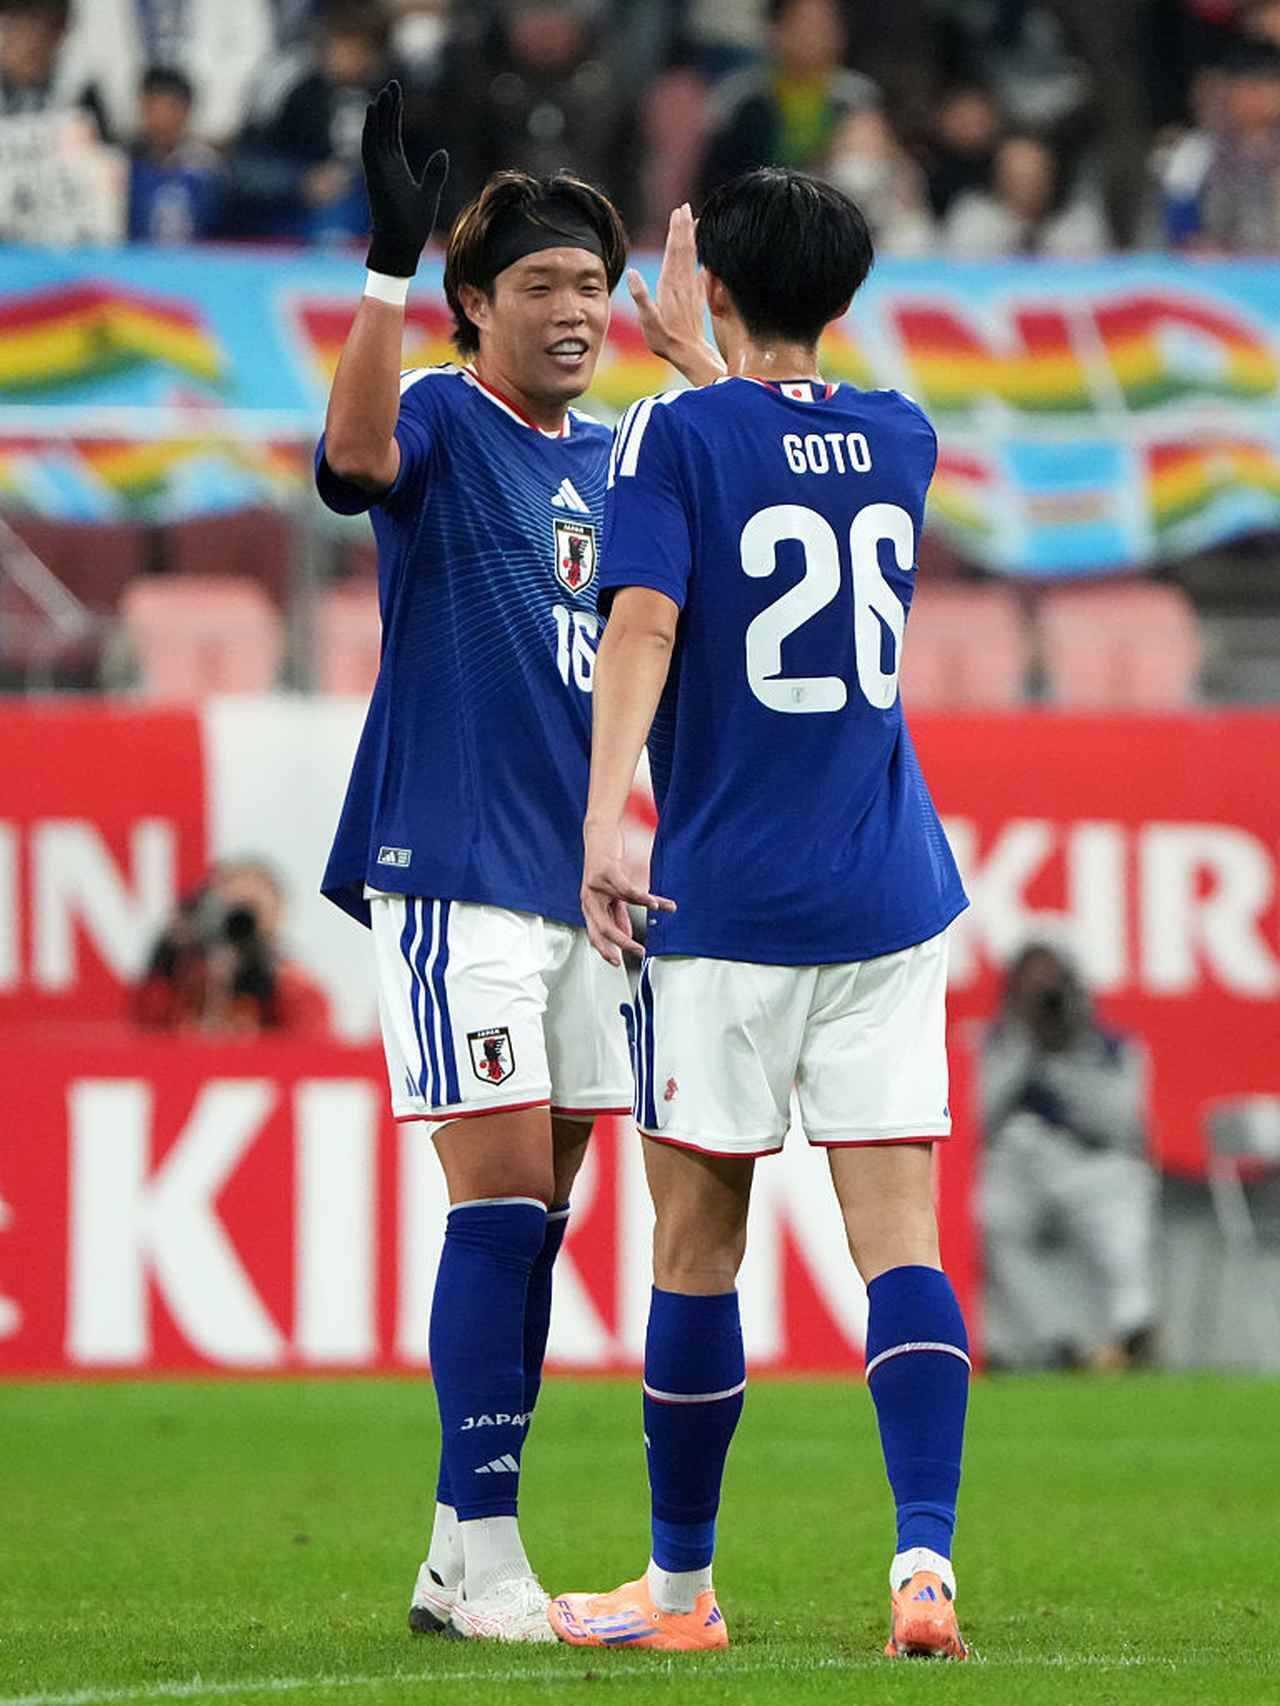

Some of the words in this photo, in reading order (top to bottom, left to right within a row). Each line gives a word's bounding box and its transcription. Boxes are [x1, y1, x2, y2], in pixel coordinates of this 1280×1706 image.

[783, 432, 873, 474] GOTO
[552, 604, 597, 692] 16
[740, 503, 916, 714] 26
[942, 814, 1280, 998] KIR
[460, 1411, 533, 1430] JAPA
